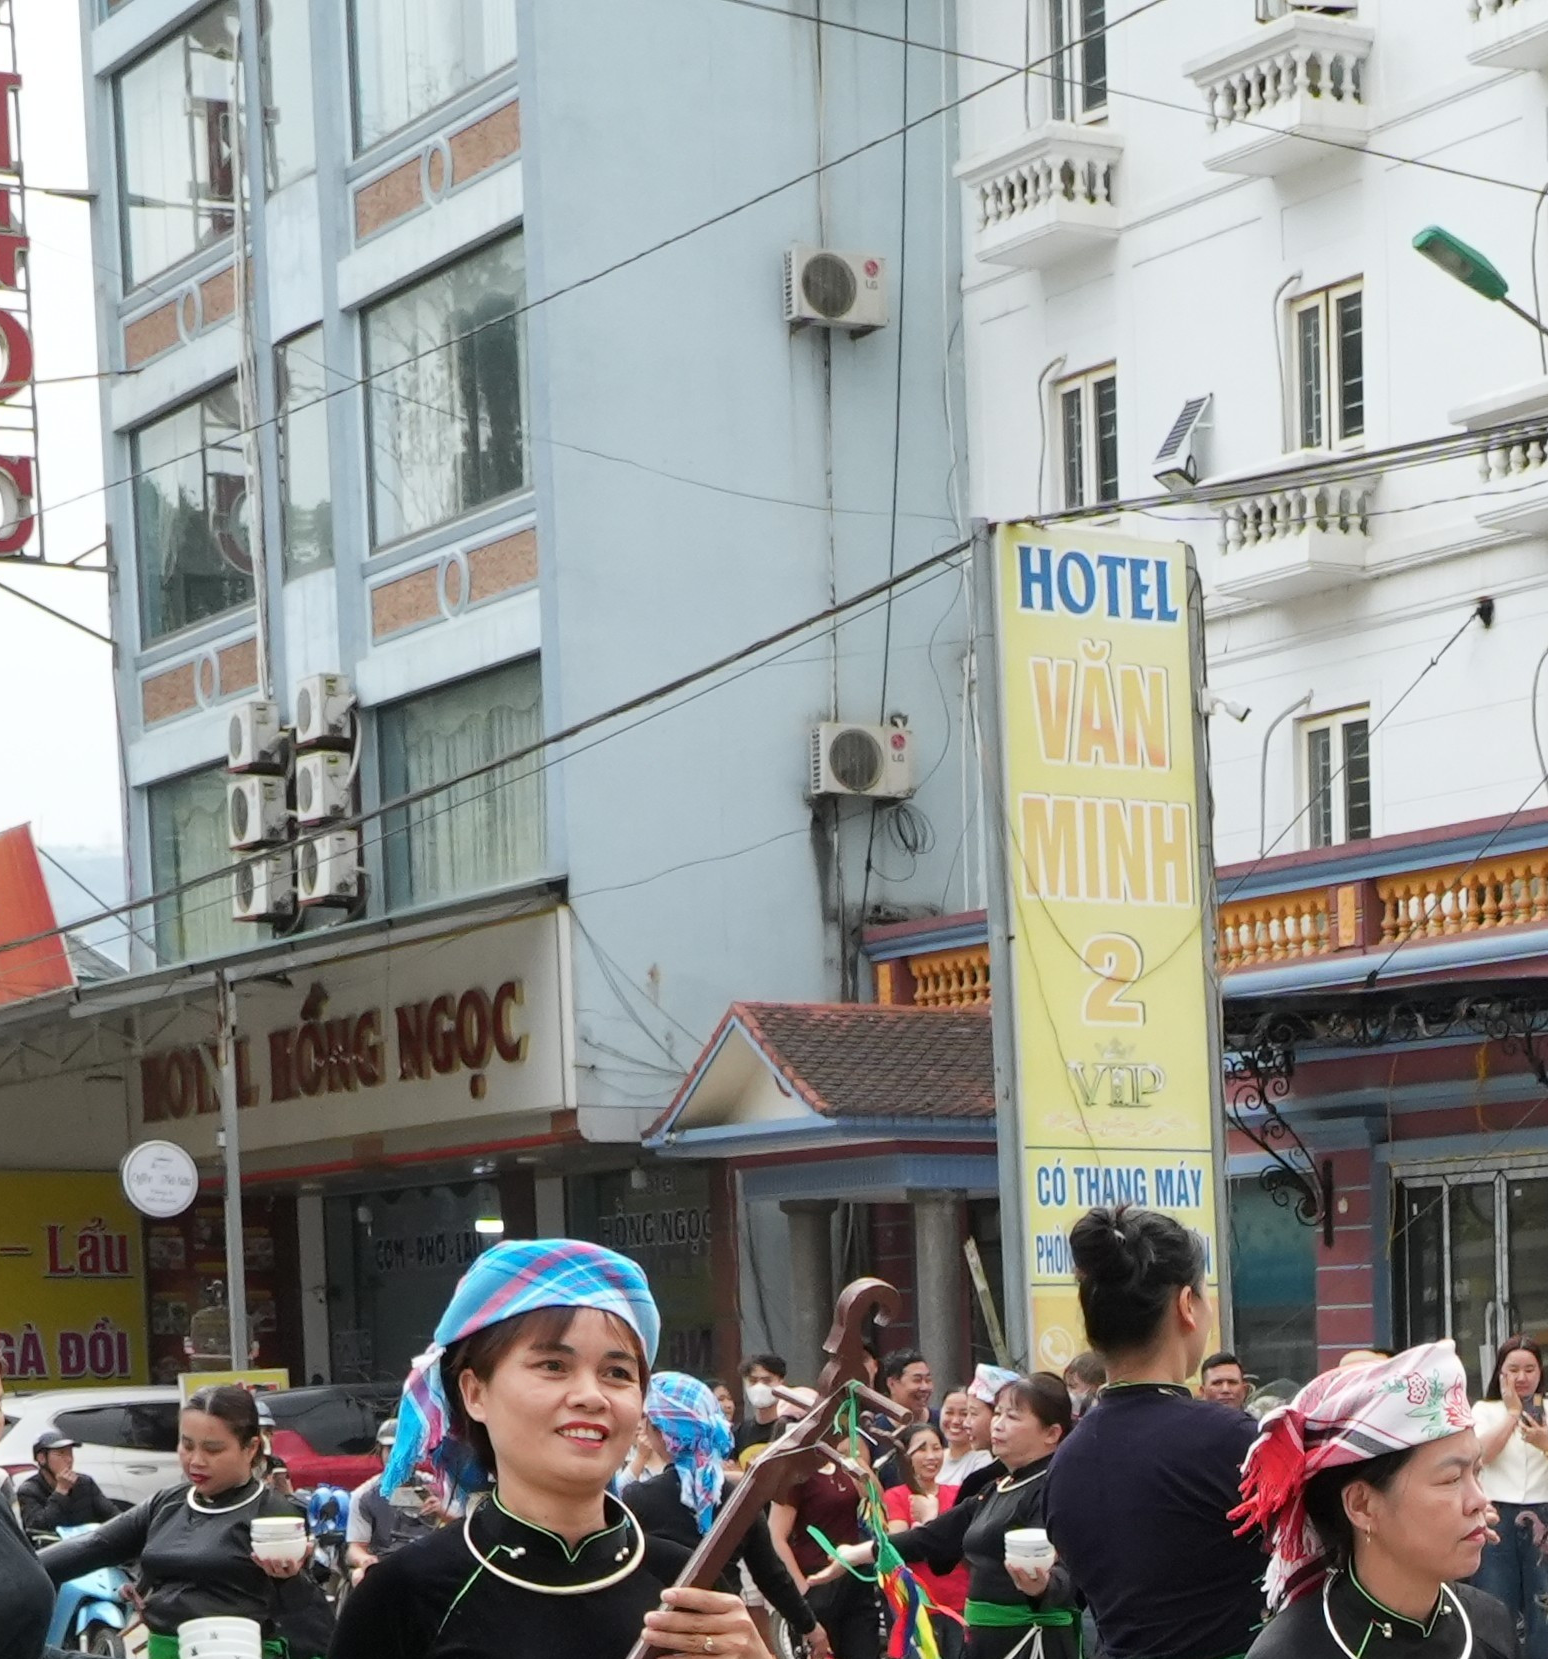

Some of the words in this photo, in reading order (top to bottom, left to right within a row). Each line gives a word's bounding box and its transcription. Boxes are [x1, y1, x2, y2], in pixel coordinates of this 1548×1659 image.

[1016, 542, 1179, 624] HOTEL
[1028, 639, 1172, 770] VĂN
[1019, 792, 1194, 908] MINH
[1080, 931, 1146, 1028] 2
[395, 978, 530, 1101] NGỌC
[1066, 1061, 1166, 1108] VIP
[1036, 1159, 1069, 1207] CÓ
[1073, 1166, 1147, 1207] THANG
[1154, 1160, 1203, 1208] MÁY
[43, 1217, 134, 1279] Lẩu
